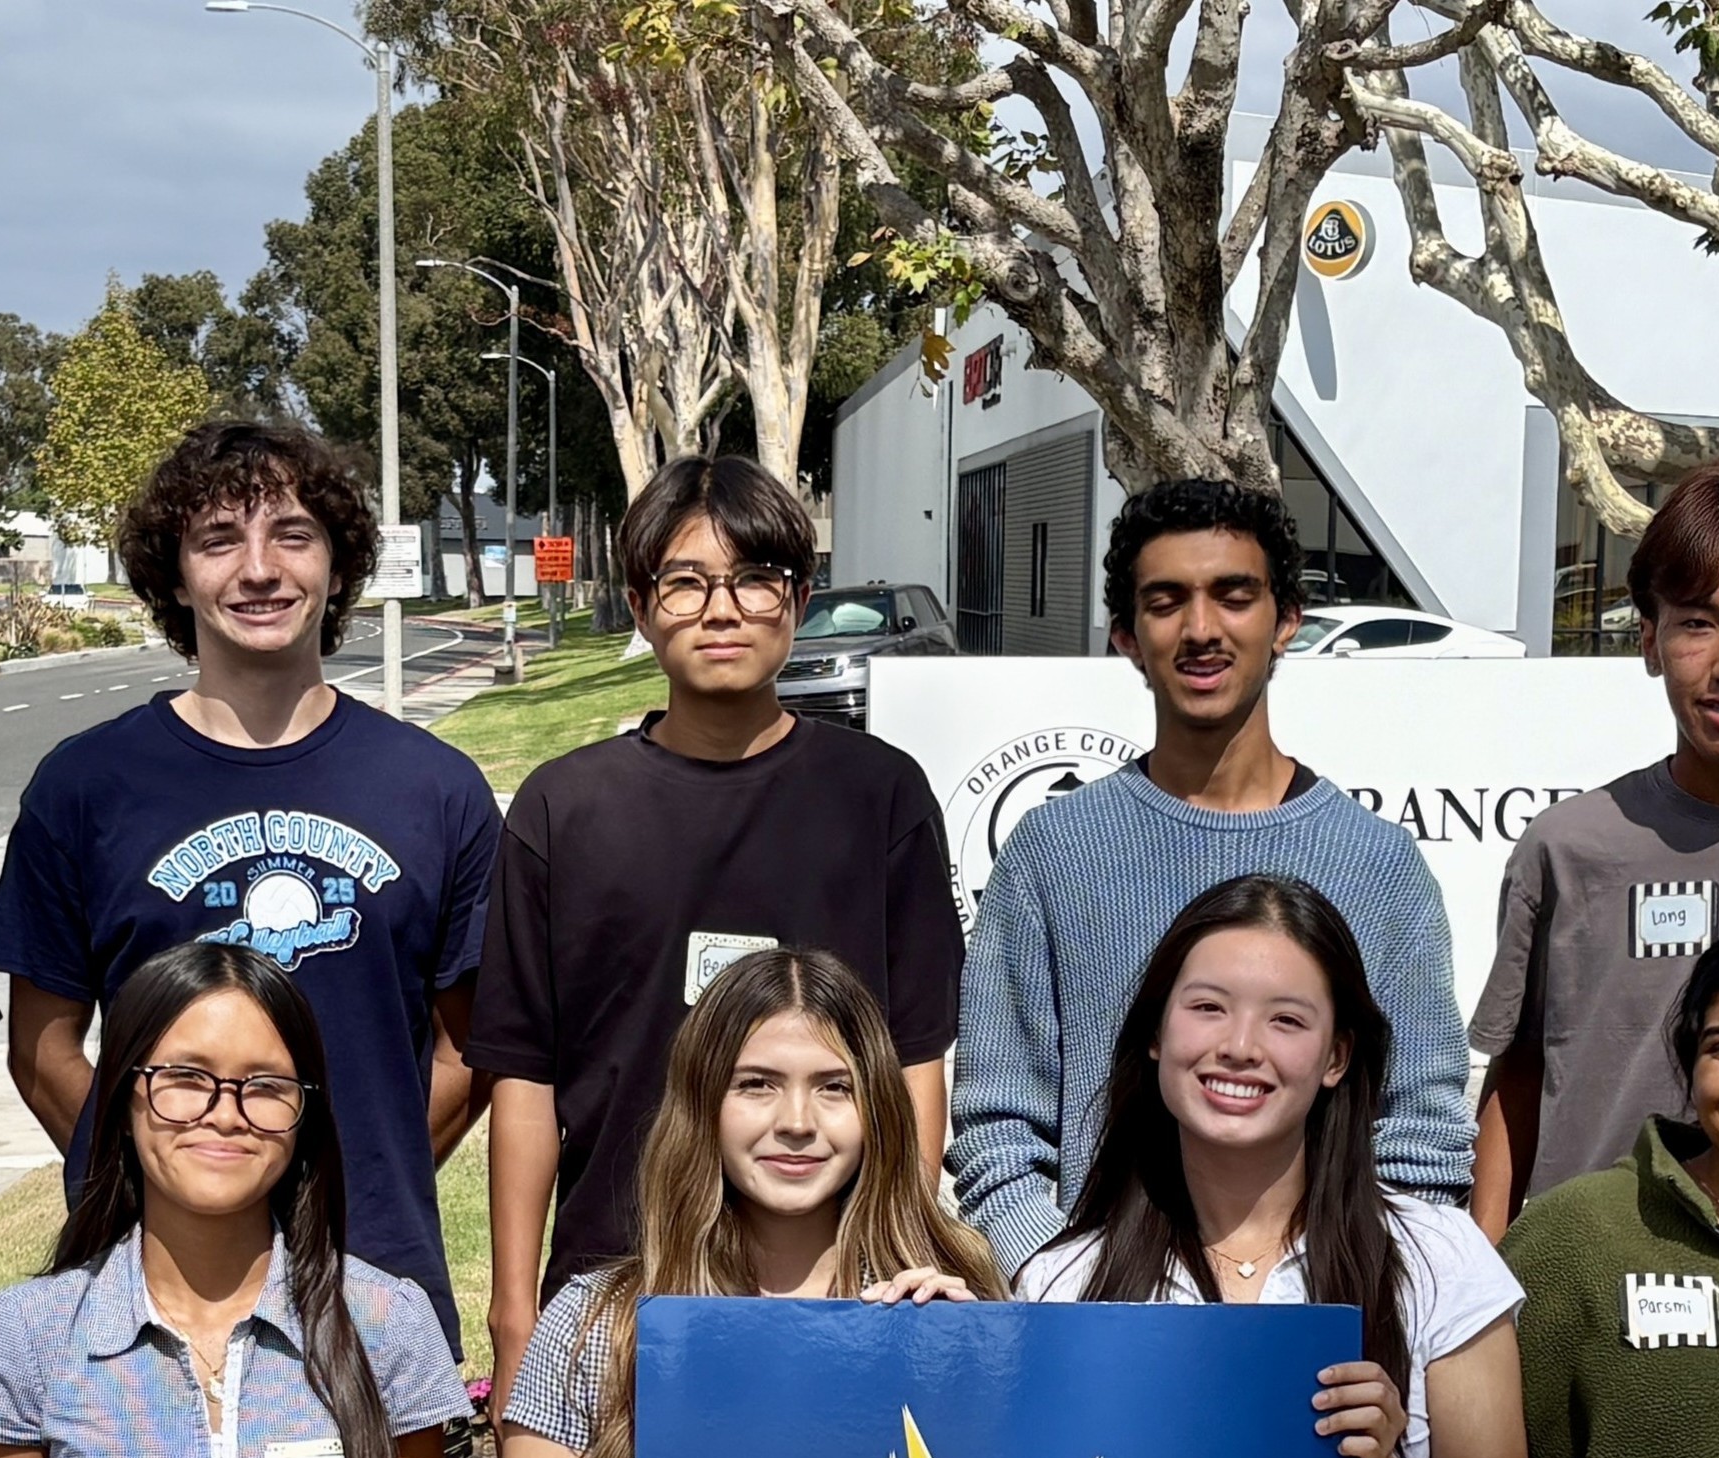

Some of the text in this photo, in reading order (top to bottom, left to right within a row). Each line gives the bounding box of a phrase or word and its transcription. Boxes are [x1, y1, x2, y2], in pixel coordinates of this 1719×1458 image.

[1308, 235, 1357, 256] LOTUS
[967, 732, 1136, 796] ORANGE COU
[149, 810, 401, 902] NORTH COUNTY
[247, 856, 317, 882] SUMMER
[203, 881, 238, 908] 20
[322, 877, 356, 904] 25
[1652, 909, 1686, 926] Long
